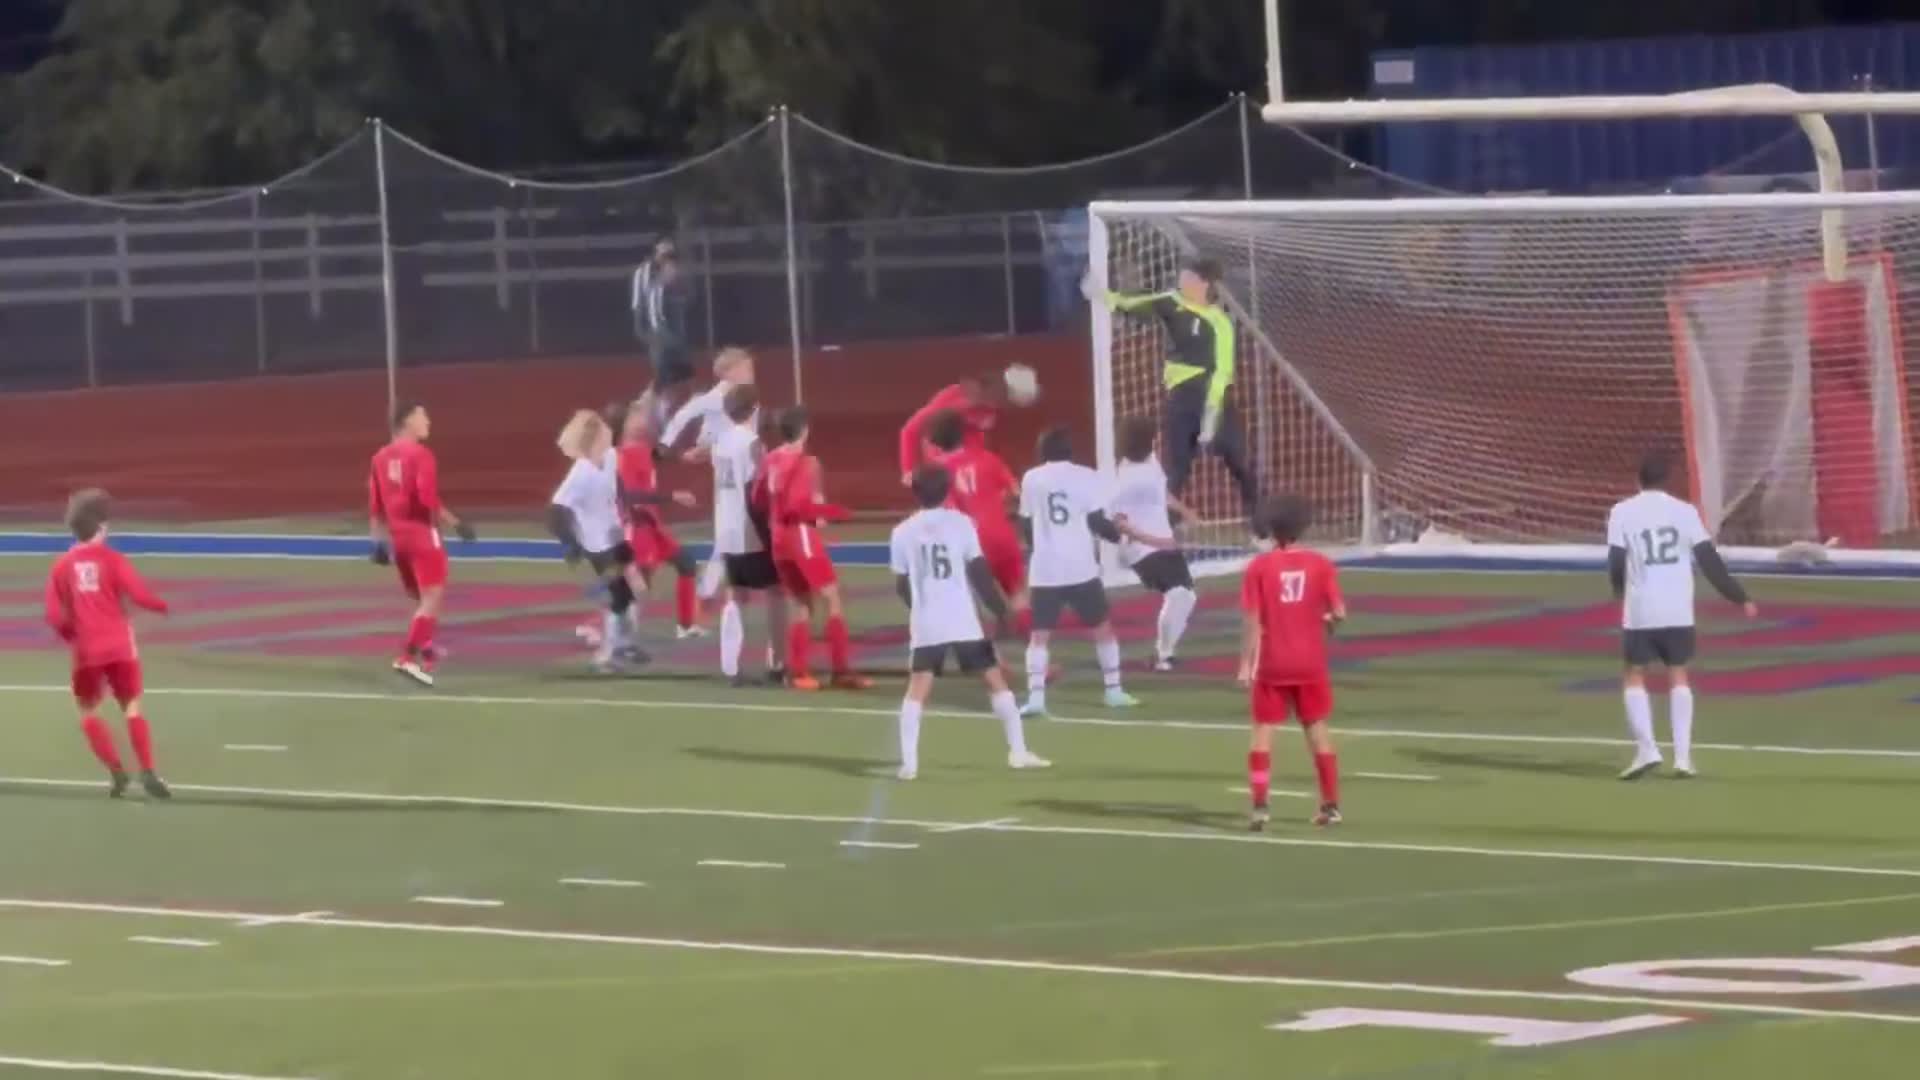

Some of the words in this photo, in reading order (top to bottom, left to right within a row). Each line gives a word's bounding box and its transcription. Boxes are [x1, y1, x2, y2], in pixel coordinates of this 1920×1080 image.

[1048, 489, 1069, 524] 6
[920, 543, 952, 579] 16
[1641, 527, 1679, 566] 12
[1280, 570, 1306, 602] 37
